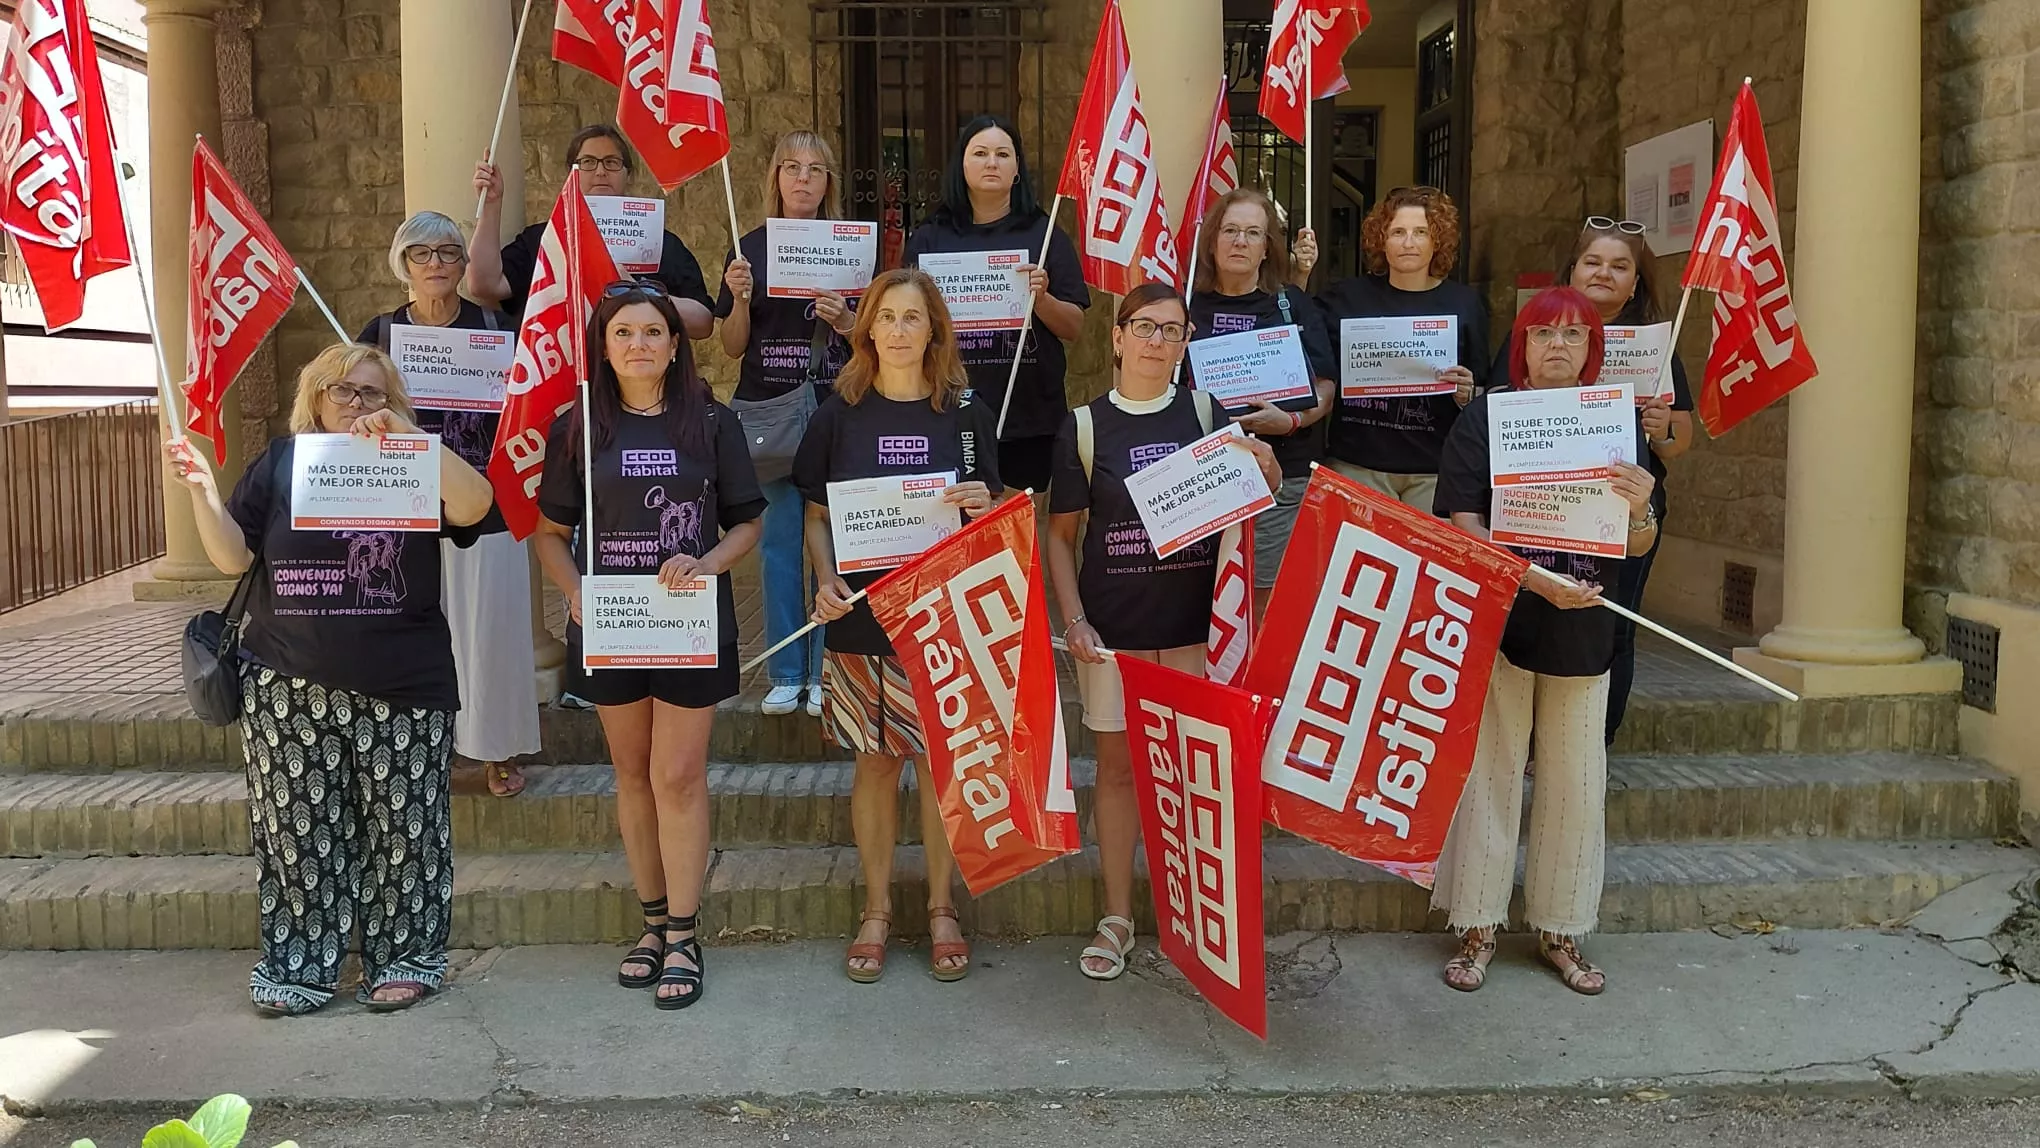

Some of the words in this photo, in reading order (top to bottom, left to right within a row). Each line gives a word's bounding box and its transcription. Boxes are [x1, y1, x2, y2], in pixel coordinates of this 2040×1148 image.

[596, 218, 639, 227] ENFERMA
[608, 229, 647, 239] FRAUDE,
[778, 246, 835, 255] ESENCIALES
[778, 256, 860, 266] IMPRESCINDIBLES
[962, 273, 1005, 283] ENFERMA
[975, 284, 1013, 292] FRAUDE,
[960, 294, 1003, 303] DERECHO
[403, 344, 452, 354] TRABAJO
[978, 339, 993, 349] YA!
[1365, 351, 1406, 359] LIMPIEZA
[1615, 348, 1658, 357] TRABAJO
[403, 355, 456, 366] ESENCIAL,
[763, 358, 797, 368] DIGNOS
[1202, 354, 1245, 367] LIMPIAMOS
[1246, 350, 1281, 360] VUESTRA
[403, 365, 448, 375] SALARIO
[451, 369, 483, 377] DIGNO
[1203, 364, 1241, 375] SUCIEDAD
[1250, 359, 1267, 368] NOS
[1613, 367, 1658, 375] DERECHOS
[1235, 369, 1252, 378] CON
[1206, 376, 1259, 389] PRECARIEDAD
[1582, 392, 1610, 400] CCOO
[1580, 401, 1612, 409] hábitat
[1502, 421, 1511, 429] SI
[1514, 419, 1543, 428] SUBE
[1546, 417, 1582, 426] TODO,
[1502, 429, 1562, 440] NUESTROS
[1566, 425, 1622, 436] SALARIOS
[381, 441, 414, 449] CCOO
[881, 438, 926, 451] CCOO
[1503, 439, 1553, 451] TAMBIÉN
[379, 451, 416, 460] hábitat
[624, 451, 674, 463] CCOO
[961, 431, 976, 474] BIMBA
[1196, 447, 1228, 466] hábitat
[878, 454, 929, 464] hábitat
[309, 463, 336, 474] MÁS
[340, 466, 407, 475] DERECHOS
[622, 465, 678, 476] hábitat
[1520, 473, 1564, 481] CONVENIOS
[1564, 471, 1595, 479] DIGNOS
[309, 478, 315, 486] Y
[320, 478, 362, 487] MEJOR
[367, 479, 420, 488] SALARIO
[904, 480, 933, 489] CCOO
[1148, 490, 1171, 507] MÁS
[1172, 463, 1227, 496] DERECHOS
[903, 490, 936, 499] hábitat
[1152, 509, 1161, 517] Y
[1163, 492, 1196, 514] MEJOR
[1197, 469, 1242, 495] SALARIO
[1558, 486, 1603, 496] VUESTRA
[1504, 490, 1550, 500] SUCIEDAD
[1552, 494, 1559, 502] Y
[1561, 495, 1582, 504] NOS
[1503, 499, 1537, 510] PAGÁIS
[1539, 503, 1560, 511] CON
[845, 510, 885, 523] ¡BASTA
[887, 507, 901, 517] DE
[1503, 509, 1566, 521] PRECARIEDAD
[845, 516, 925, 533] PRECARIEDAD!
[1177, 524, 1213, 544] CONVENIOS
[1213, 513, 1238, 528] DIGNOS
[1515, 536, 1556, 546] CONVENIOS
[1557, 540, 1584, 549] DIGNOS
[1108, 543, 1145, 556] DIGNOS
[639, 555, 658, 567] YA!
[861, 558, 899, 567] CONVENIOS
[274, 569, 346, 581] ¡CONVENIOS
[277, 583, 318, 596] DIGNOS
[322, 583, 343, 596] YA!
[596, 597, 649, 605] TRABAJO
[596, 608, 654, 618] ESENCIAL,
[596, 620, 645, 628] SALARIO
[648, 620, 684, 628] DIGNO
[687, 620, 710, 630] ¡YA!
[1138, 697, 1194, 948] hábitat
[1184, 738, 1234, 972] CCOO
